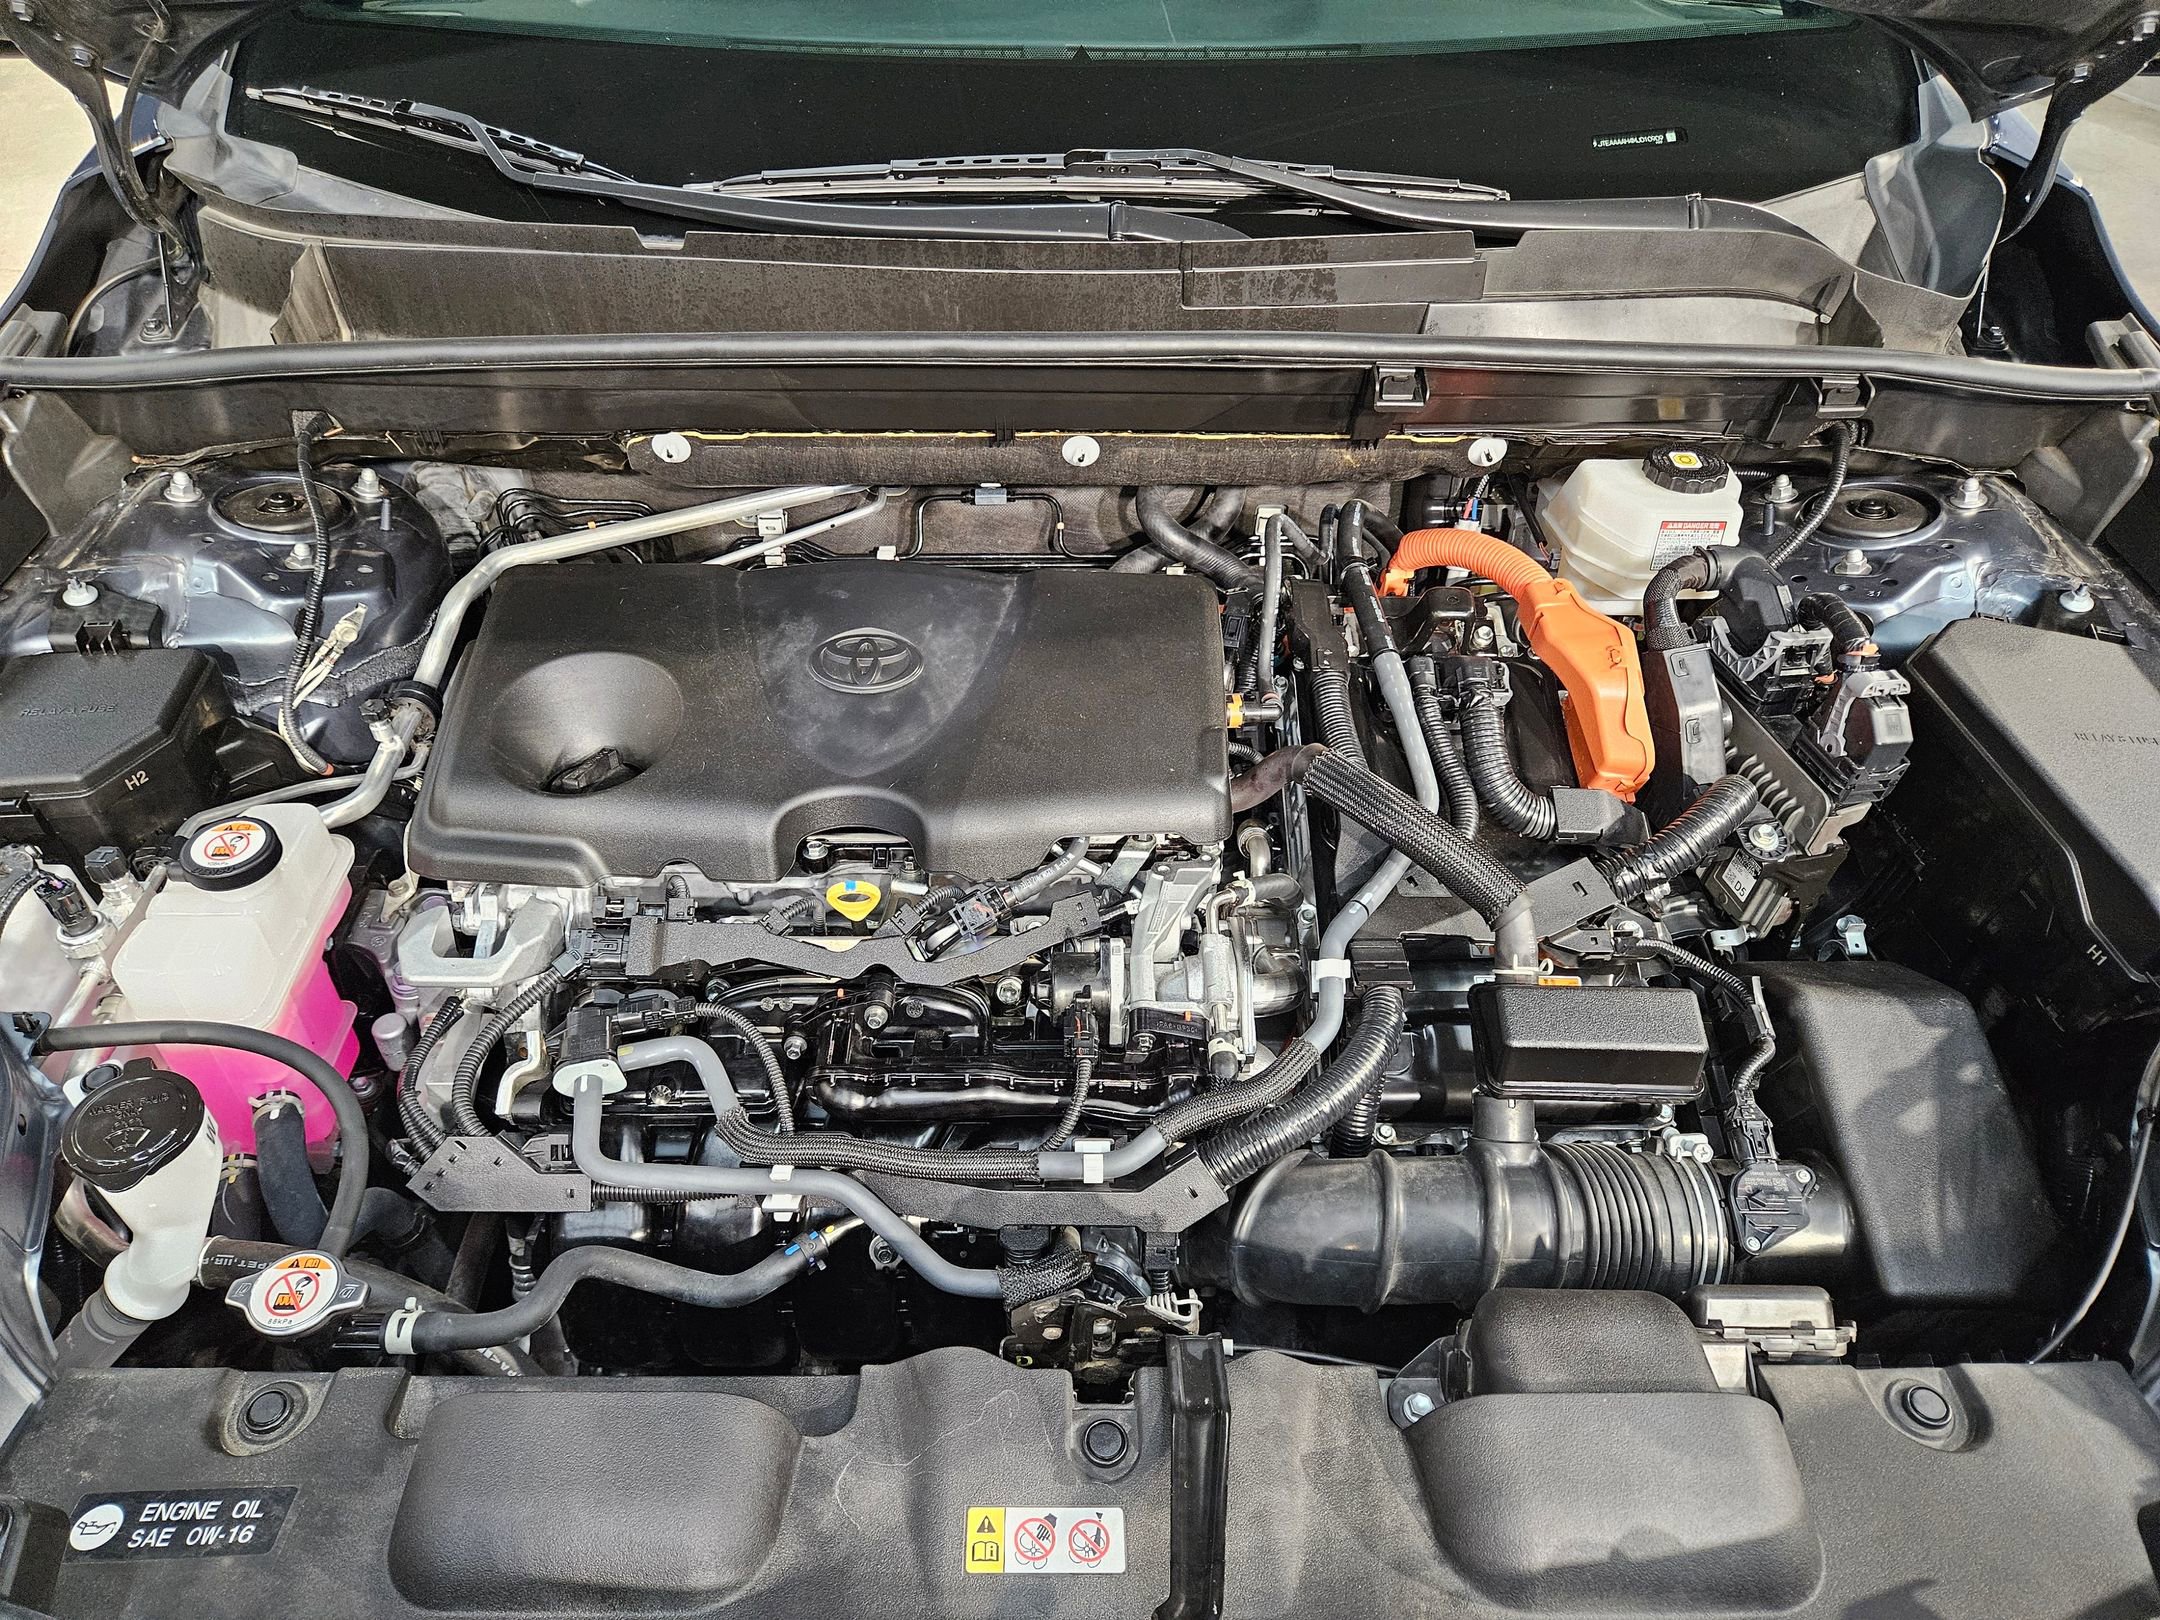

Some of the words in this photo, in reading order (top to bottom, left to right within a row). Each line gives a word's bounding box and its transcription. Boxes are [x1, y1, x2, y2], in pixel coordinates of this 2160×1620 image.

[124, 769, 150, 791] H2
[1734, 880, 1747, 897] D5
[2086, 944, 2108, 966] H1
[266, 1318, 294, 1326] 88kPa
[138, 1500, 224, 1523] ENGINE
[231, 1499, 265, 1519] OIL
[127, 1527, 178, 1549] SAE
[185, 1524, 257, 1546] 0W-16
